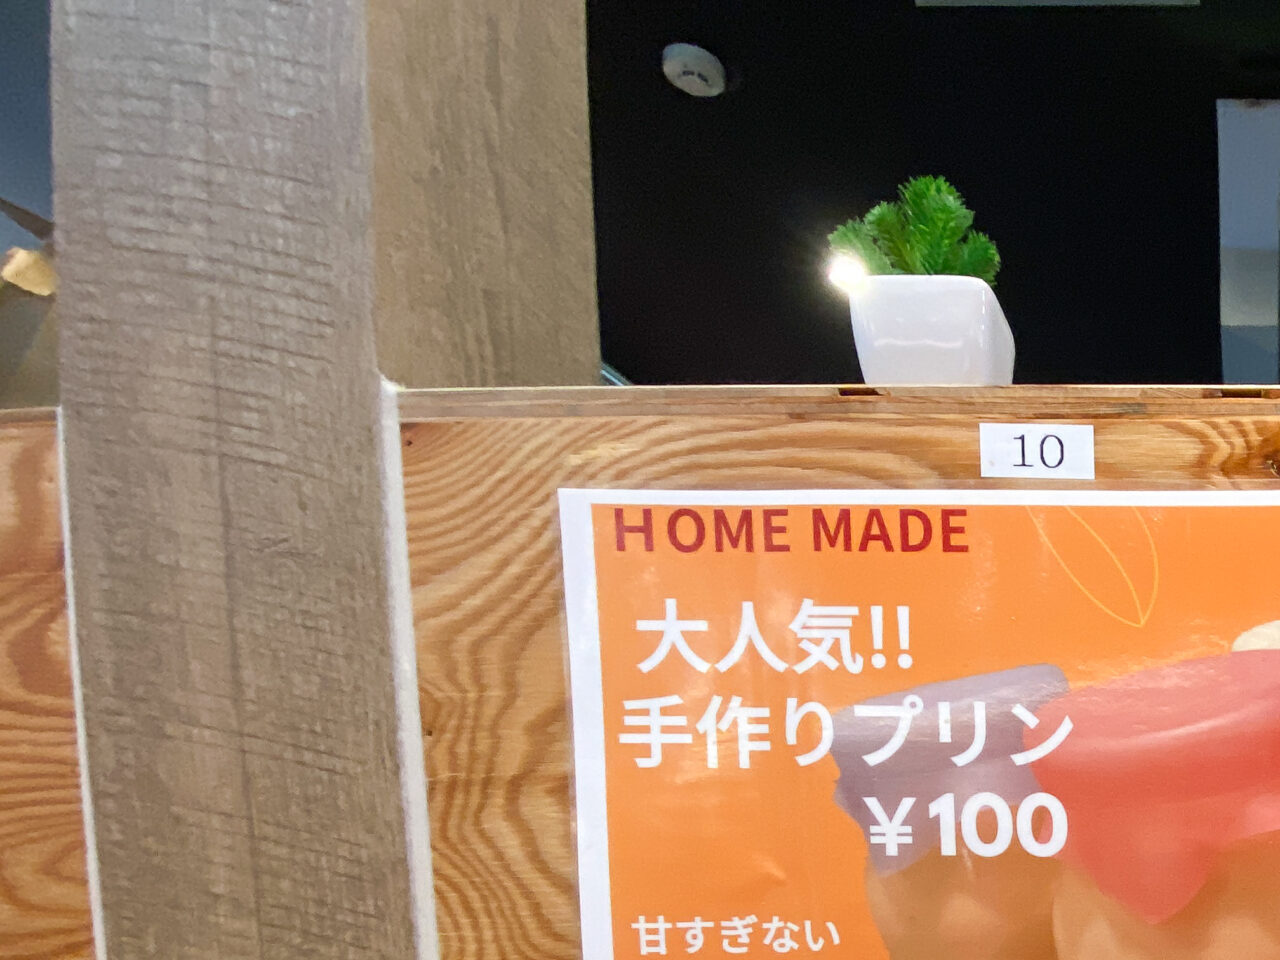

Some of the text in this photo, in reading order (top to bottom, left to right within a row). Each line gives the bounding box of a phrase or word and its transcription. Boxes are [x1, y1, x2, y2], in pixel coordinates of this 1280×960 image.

[1011, 432, 1066, 469] 10
[614, 507, 970, 553] HOME MADE
[617, 694, 1075, 770] 手作りプリン
[631, 914, 842, 956] 甘すぎない
